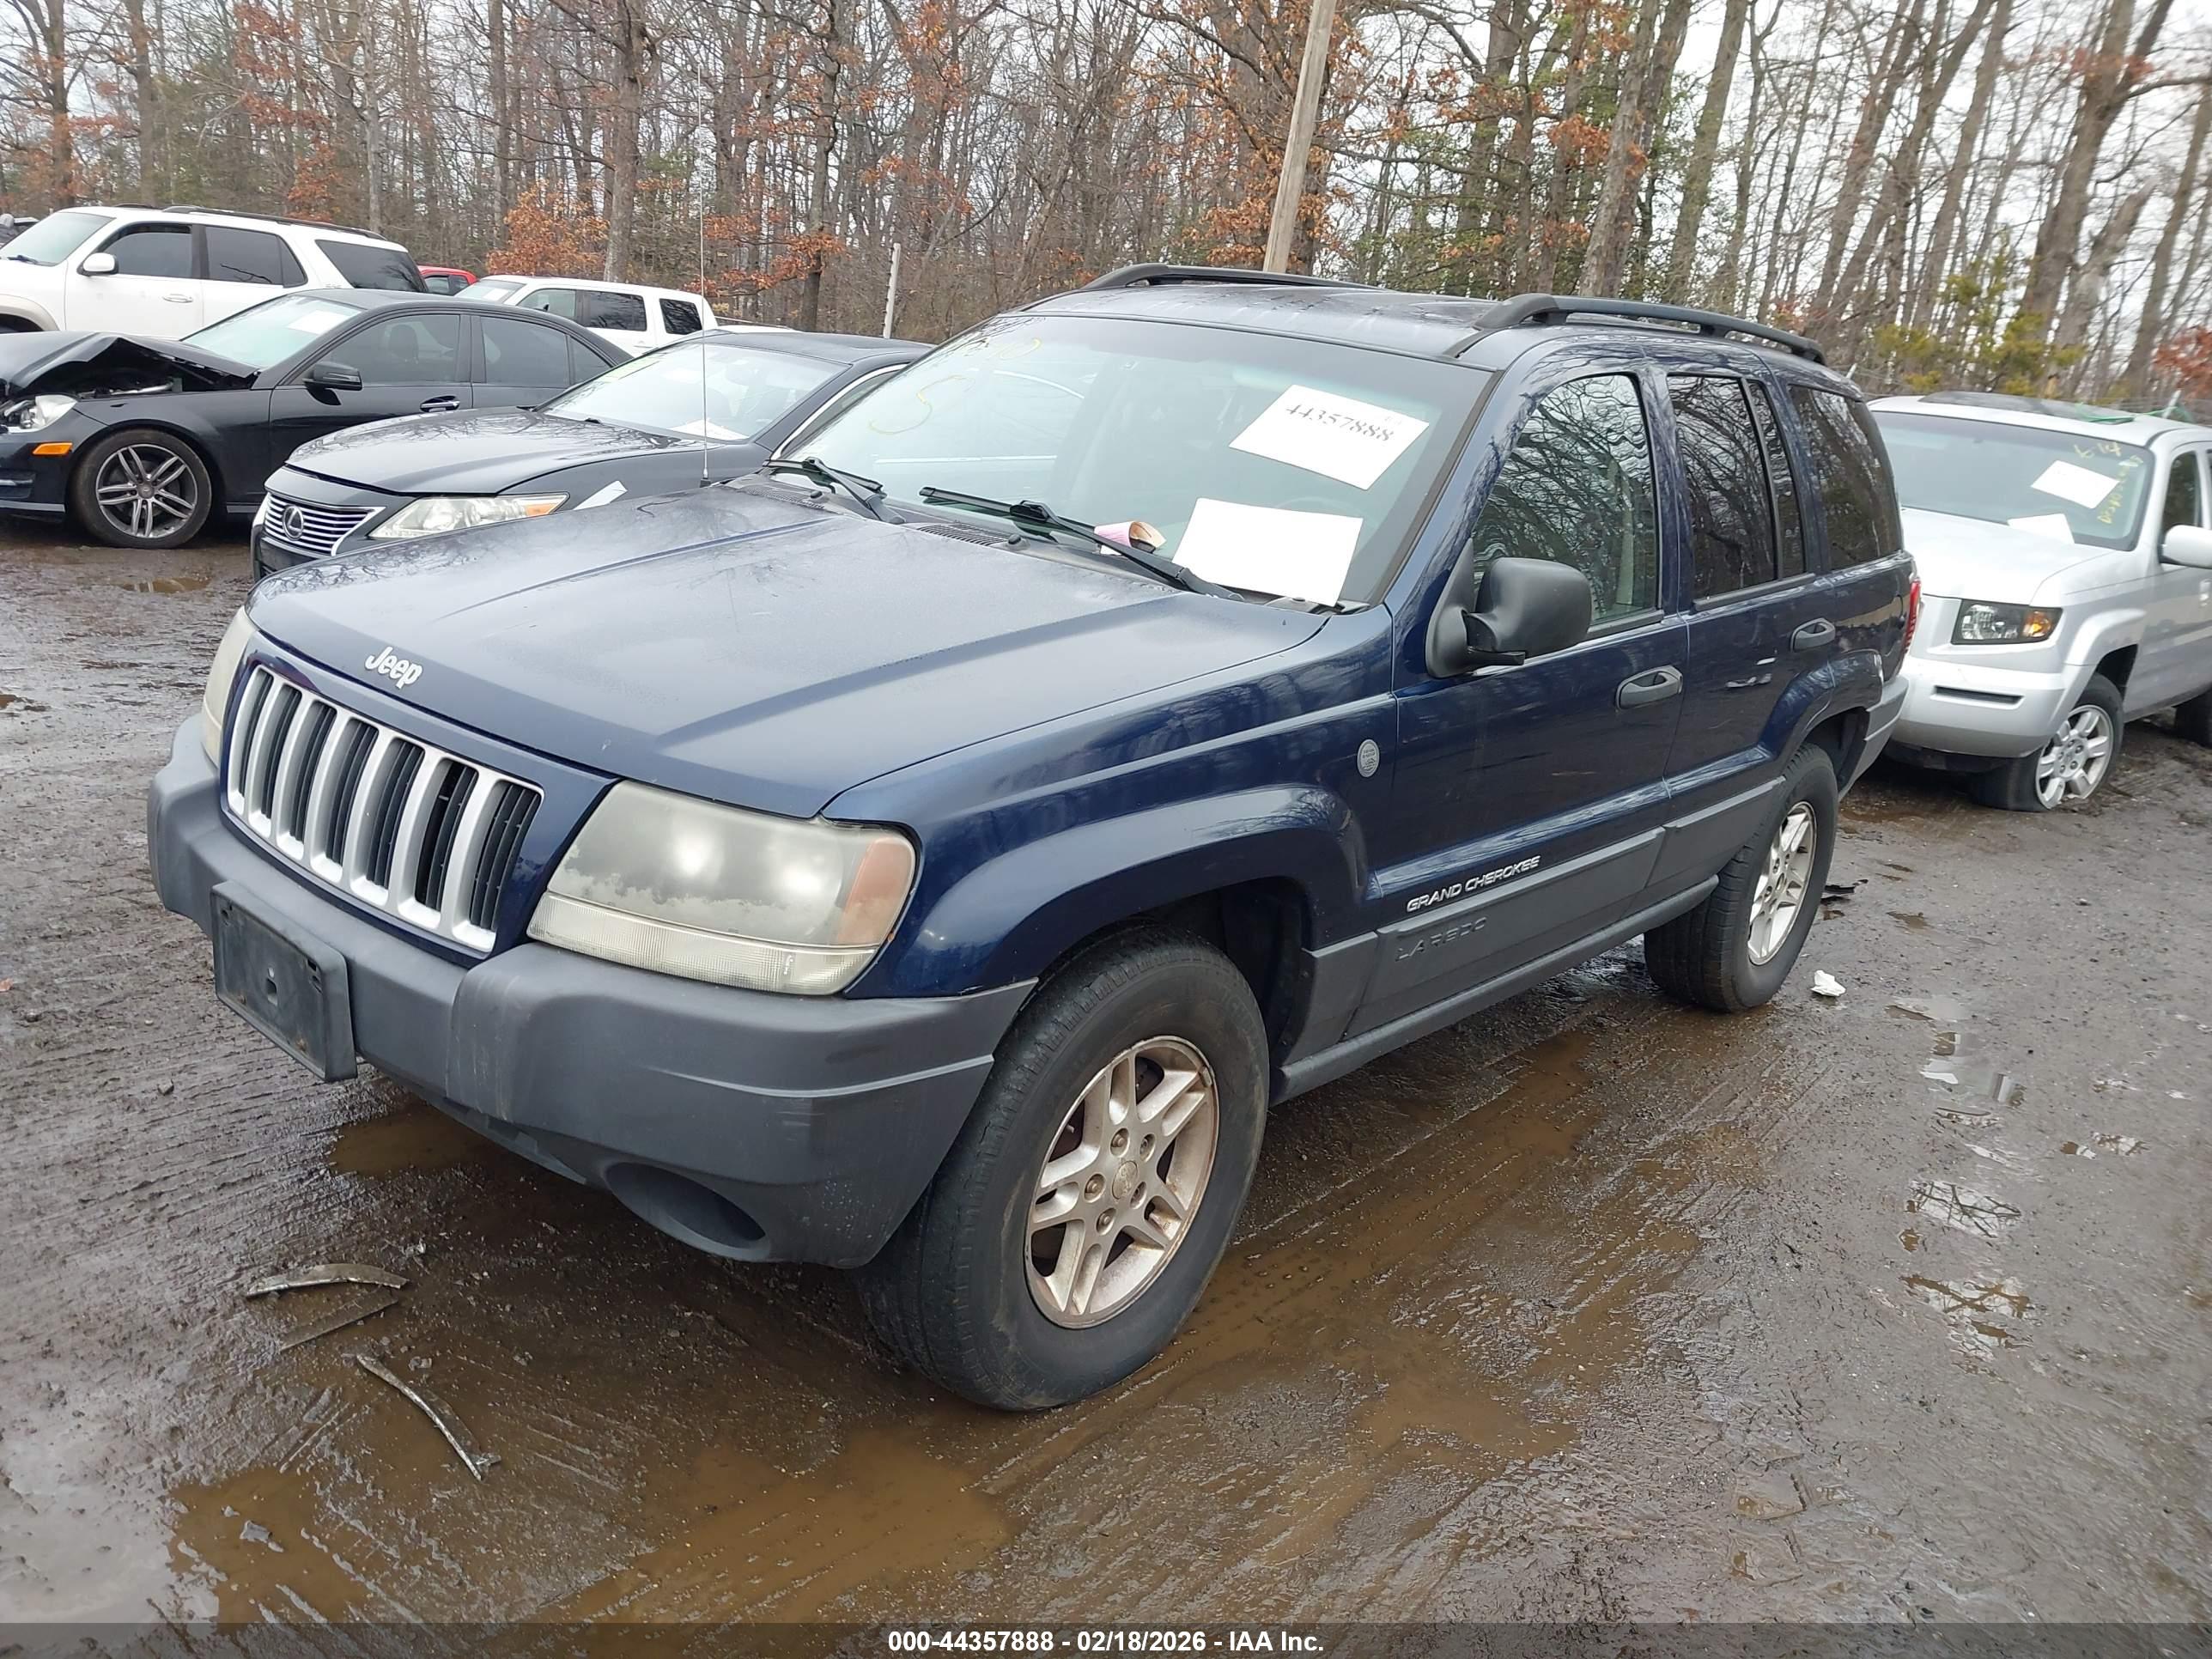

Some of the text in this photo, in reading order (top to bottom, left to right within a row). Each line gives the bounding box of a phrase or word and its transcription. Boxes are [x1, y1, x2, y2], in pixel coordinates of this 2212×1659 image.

[1286, 404, 1395, 441] 44357888
[365, 646, 422, 690] Jeep
[1407, 855, 1541, 913] GRAND CHEROKEE
[1395, 916, 1487, 962] LAREDO
